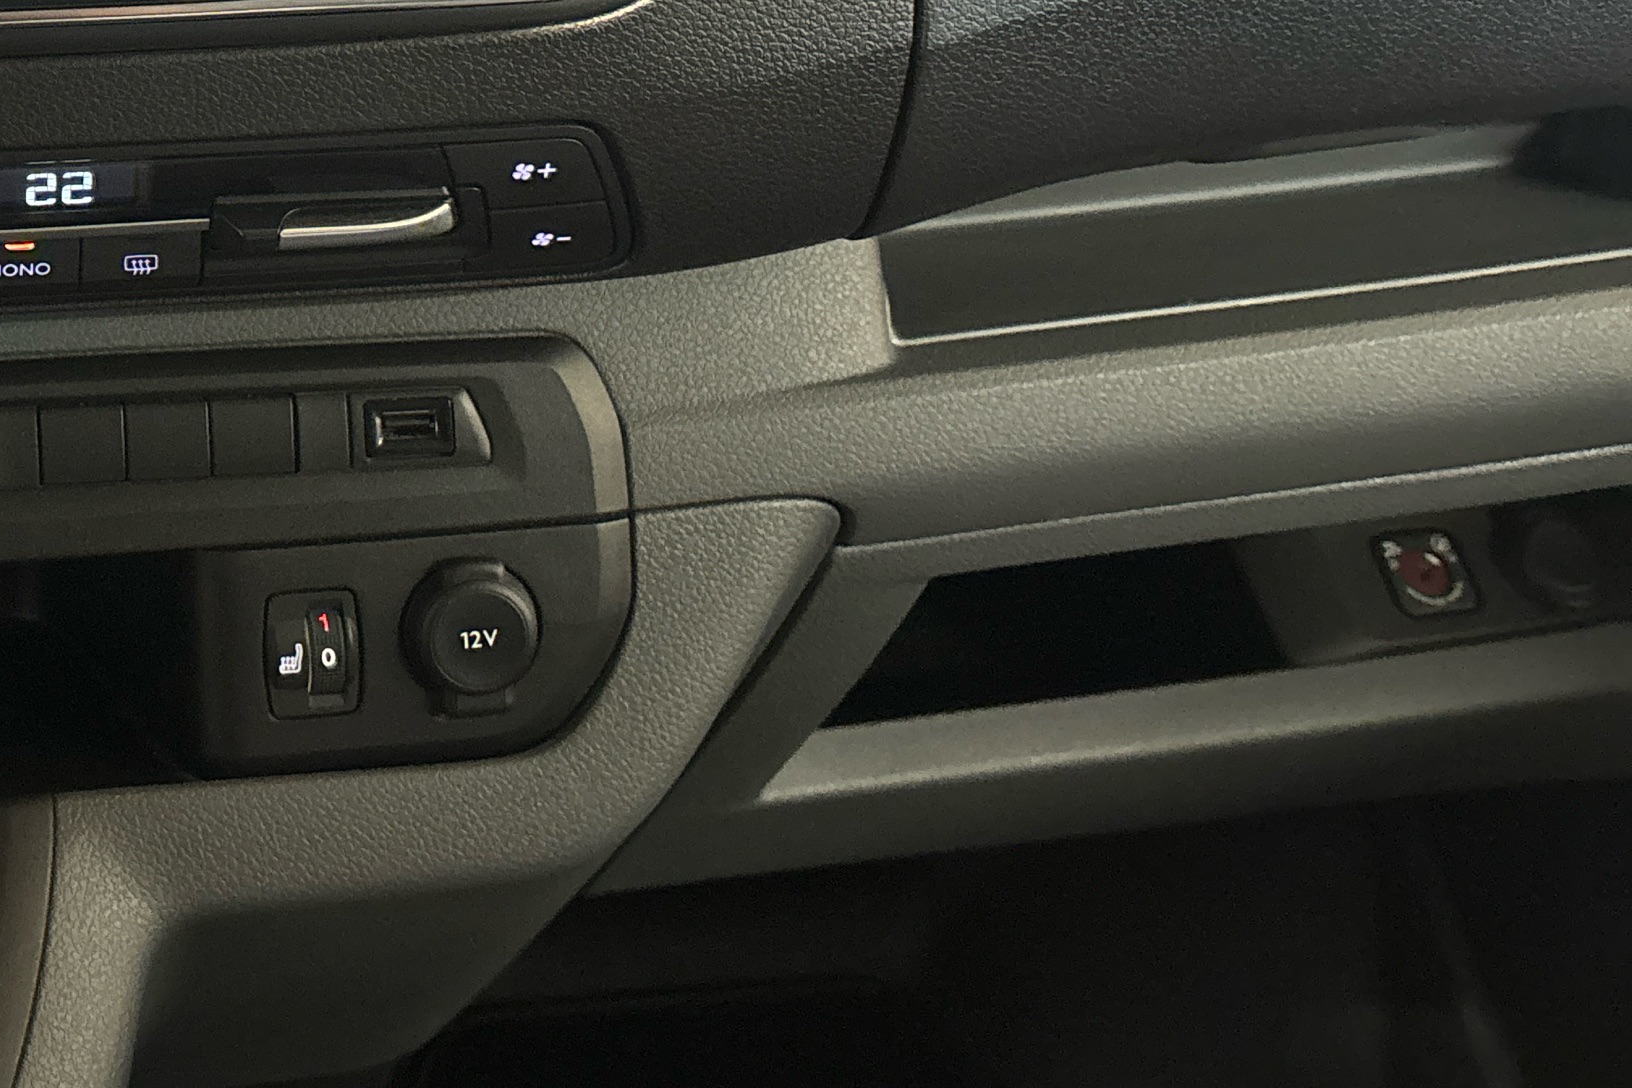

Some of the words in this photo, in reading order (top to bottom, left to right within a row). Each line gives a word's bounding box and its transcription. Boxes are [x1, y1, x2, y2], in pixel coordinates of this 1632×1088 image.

[25, 171, 94, 207] 22
[318, 613, 330, 632] 1
[460, 628, 498, 650] 12V
[321, 647, 337, 668] 0
